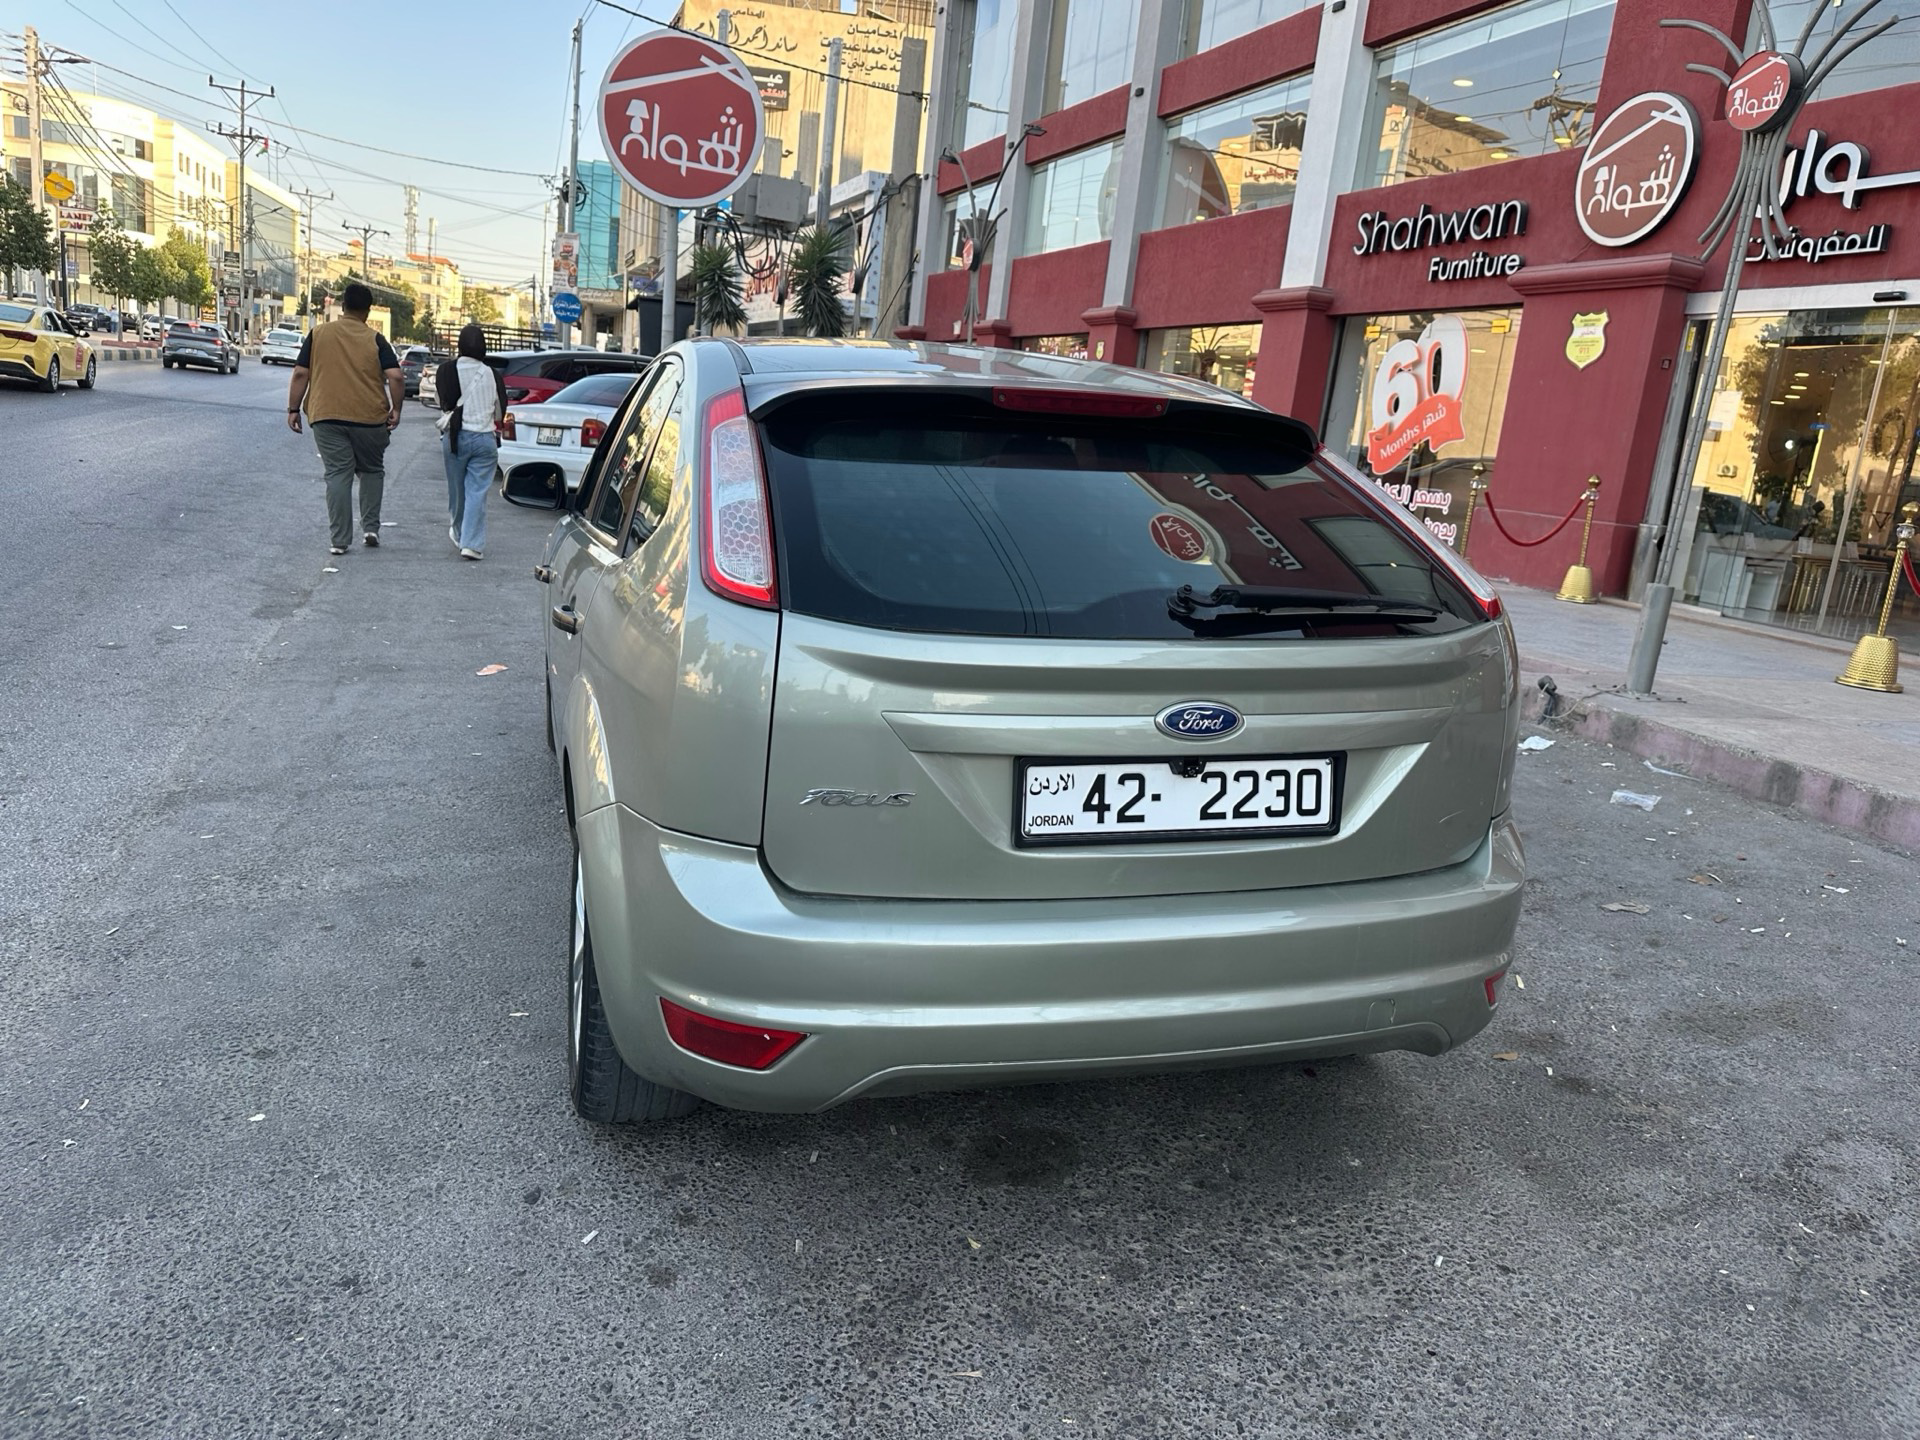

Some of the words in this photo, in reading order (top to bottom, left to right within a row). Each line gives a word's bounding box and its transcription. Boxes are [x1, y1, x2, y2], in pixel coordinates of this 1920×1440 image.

[847, 24, 903, 40] المحاميان
[1728, 75, 1785, 118] شهوان
[1585, 143, 1677, 217] شهوان
[59, 211, 94, 222] LANET
[1352, 198, 1526, 257] Shahwan
[1427, 251, 1525, 282] Furniture
[1372, 314, 1469, 430] 60
[1421, 403, 1447, 432] شهر
[1379, 424, 1421, 460] Months
[1409, 488, 1452, 515] بسعر
[1178, 707, 1224, 737] Ford
[1198, 767, 1323, 822] 2230
[1028, 814, 1075, 828] JORDAN
